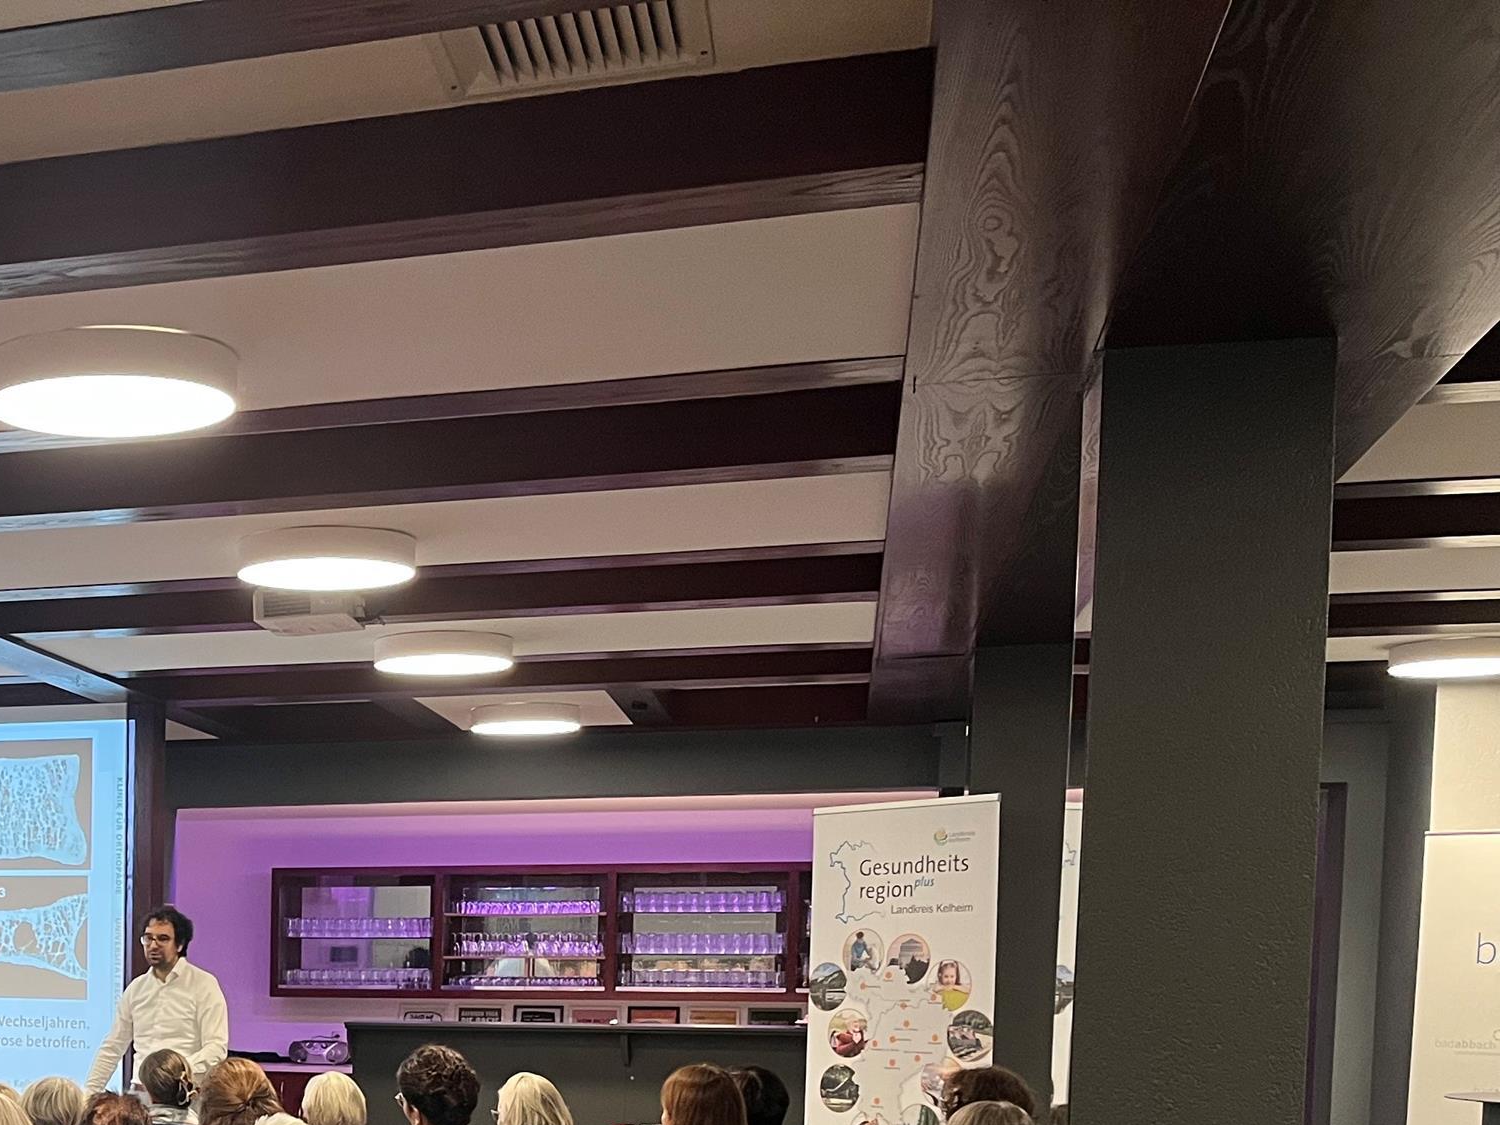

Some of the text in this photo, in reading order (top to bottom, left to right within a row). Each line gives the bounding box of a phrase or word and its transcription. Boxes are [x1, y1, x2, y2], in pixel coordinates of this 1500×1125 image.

[859, 854, 969, 877] Gesundheits
[859, 876, 935, 905] region plus
[890, 903, 974, 915] Landkreis Kelheim
[26, 1034, 91, 1050] betroffen.
